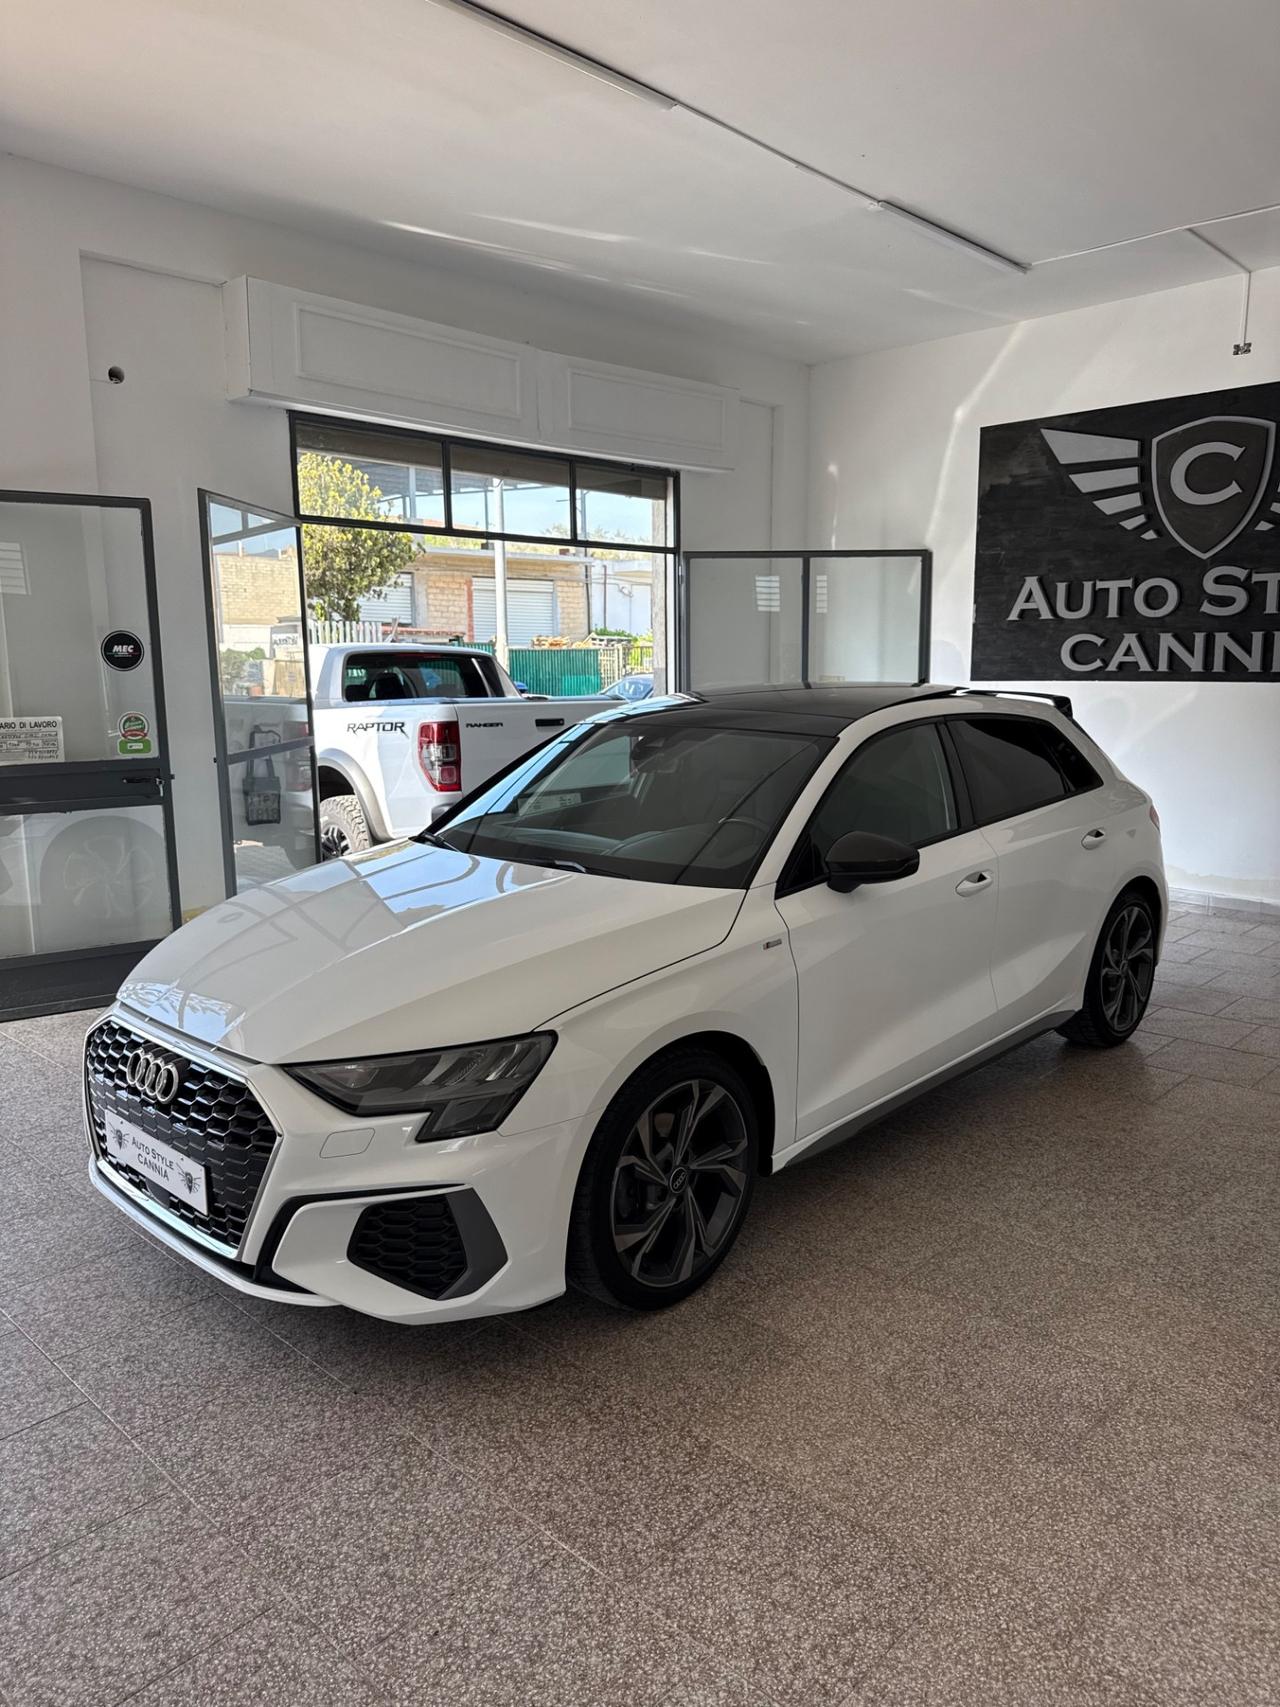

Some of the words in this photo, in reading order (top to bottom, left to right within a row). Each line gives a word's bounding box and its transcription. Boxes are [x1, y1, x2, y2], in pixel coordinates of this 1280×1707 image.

[1170, 441, 1246, 505] C
[1006, 575, 1180, 621] AUTO
[1200, 565, 1280, 617] ST
[112, 645, 134, 653] MEC
[19, 721, 27, 729] DI
[29, 720, 57, 728] LAVORO
[347, 722, 410, 738] RAPTOR
[131, 1136, 150, 1155] AUTO
[151, 1148, 174, 1171] STYLE
[137, 1153, 170, 1181] CANNIA
